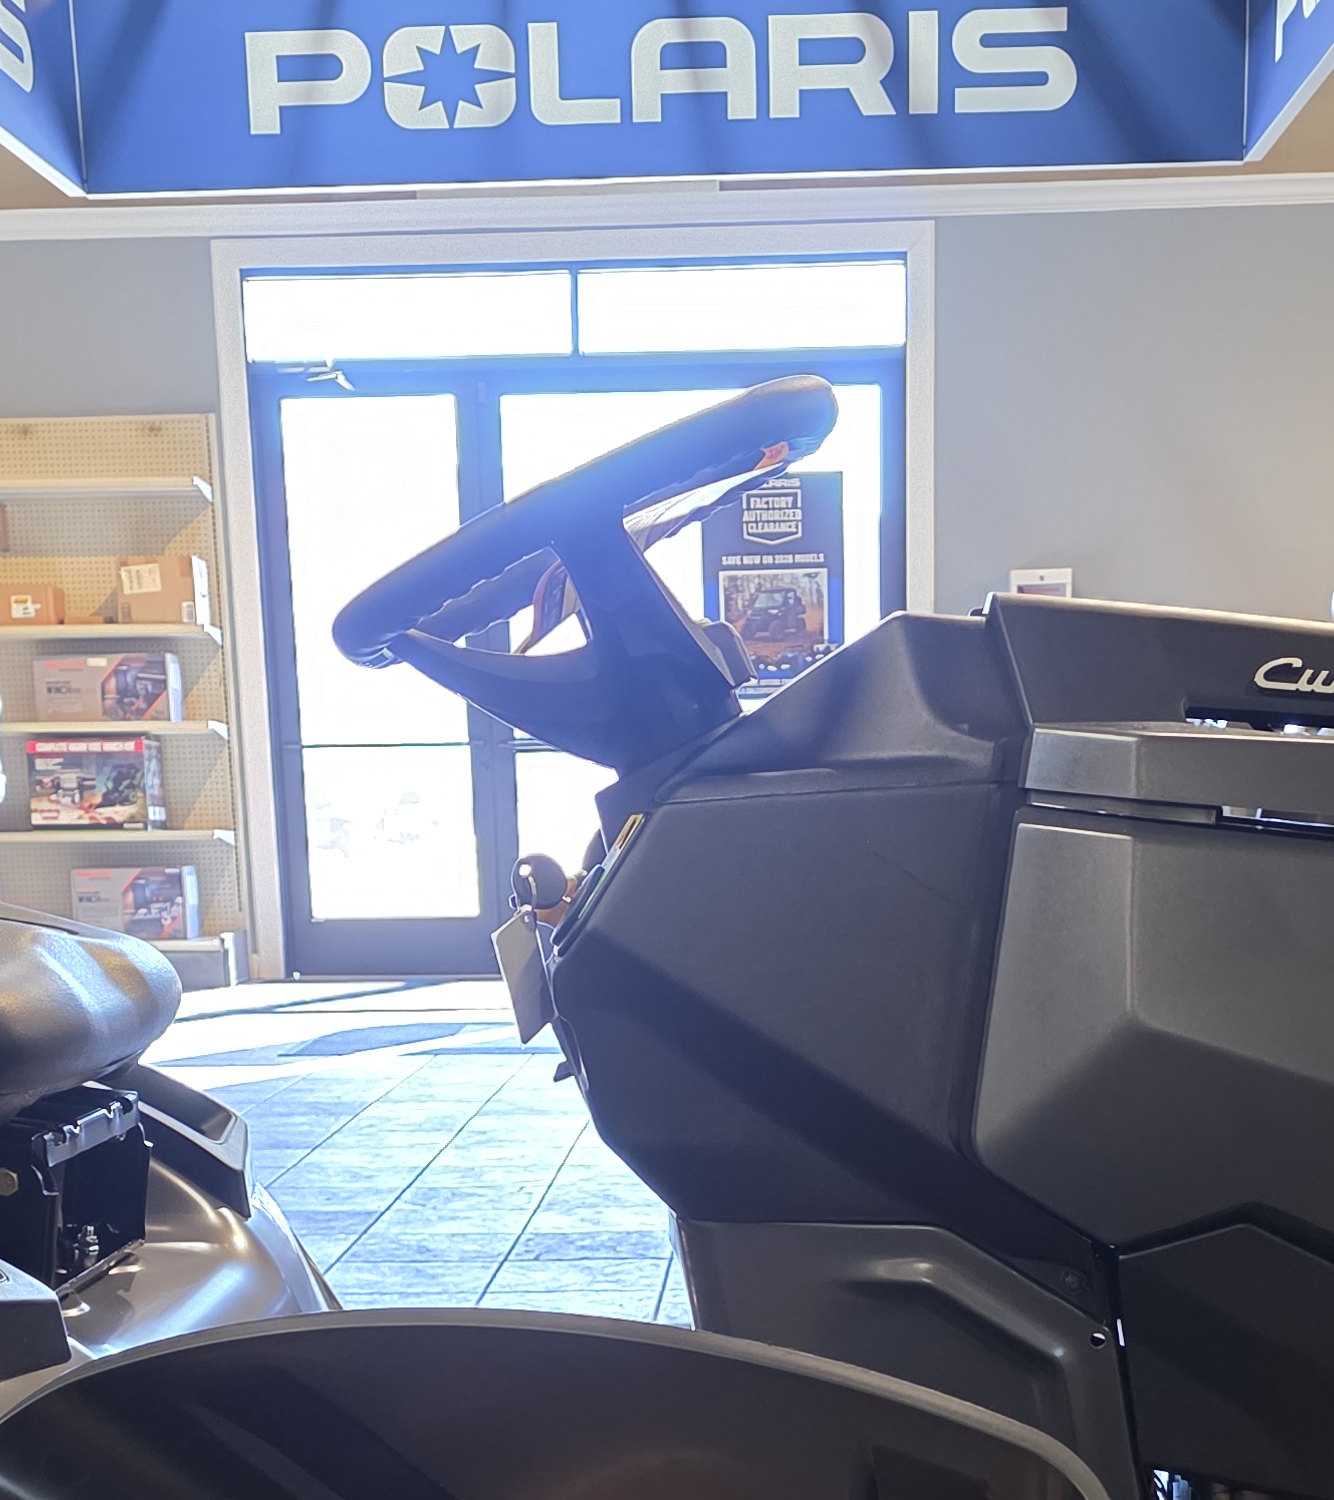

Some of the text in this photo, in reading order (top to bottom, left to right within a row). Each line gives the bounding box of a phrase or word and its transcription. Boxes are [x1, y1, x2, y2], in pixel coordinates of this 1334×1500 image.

[245, 7, 1077, 135] POLARIS
[750, 497, 793, 509] FACTORY
[742, 509, 802, 522] AUTHORIZED
[748, 522, 798, 533] CLEARANCE
